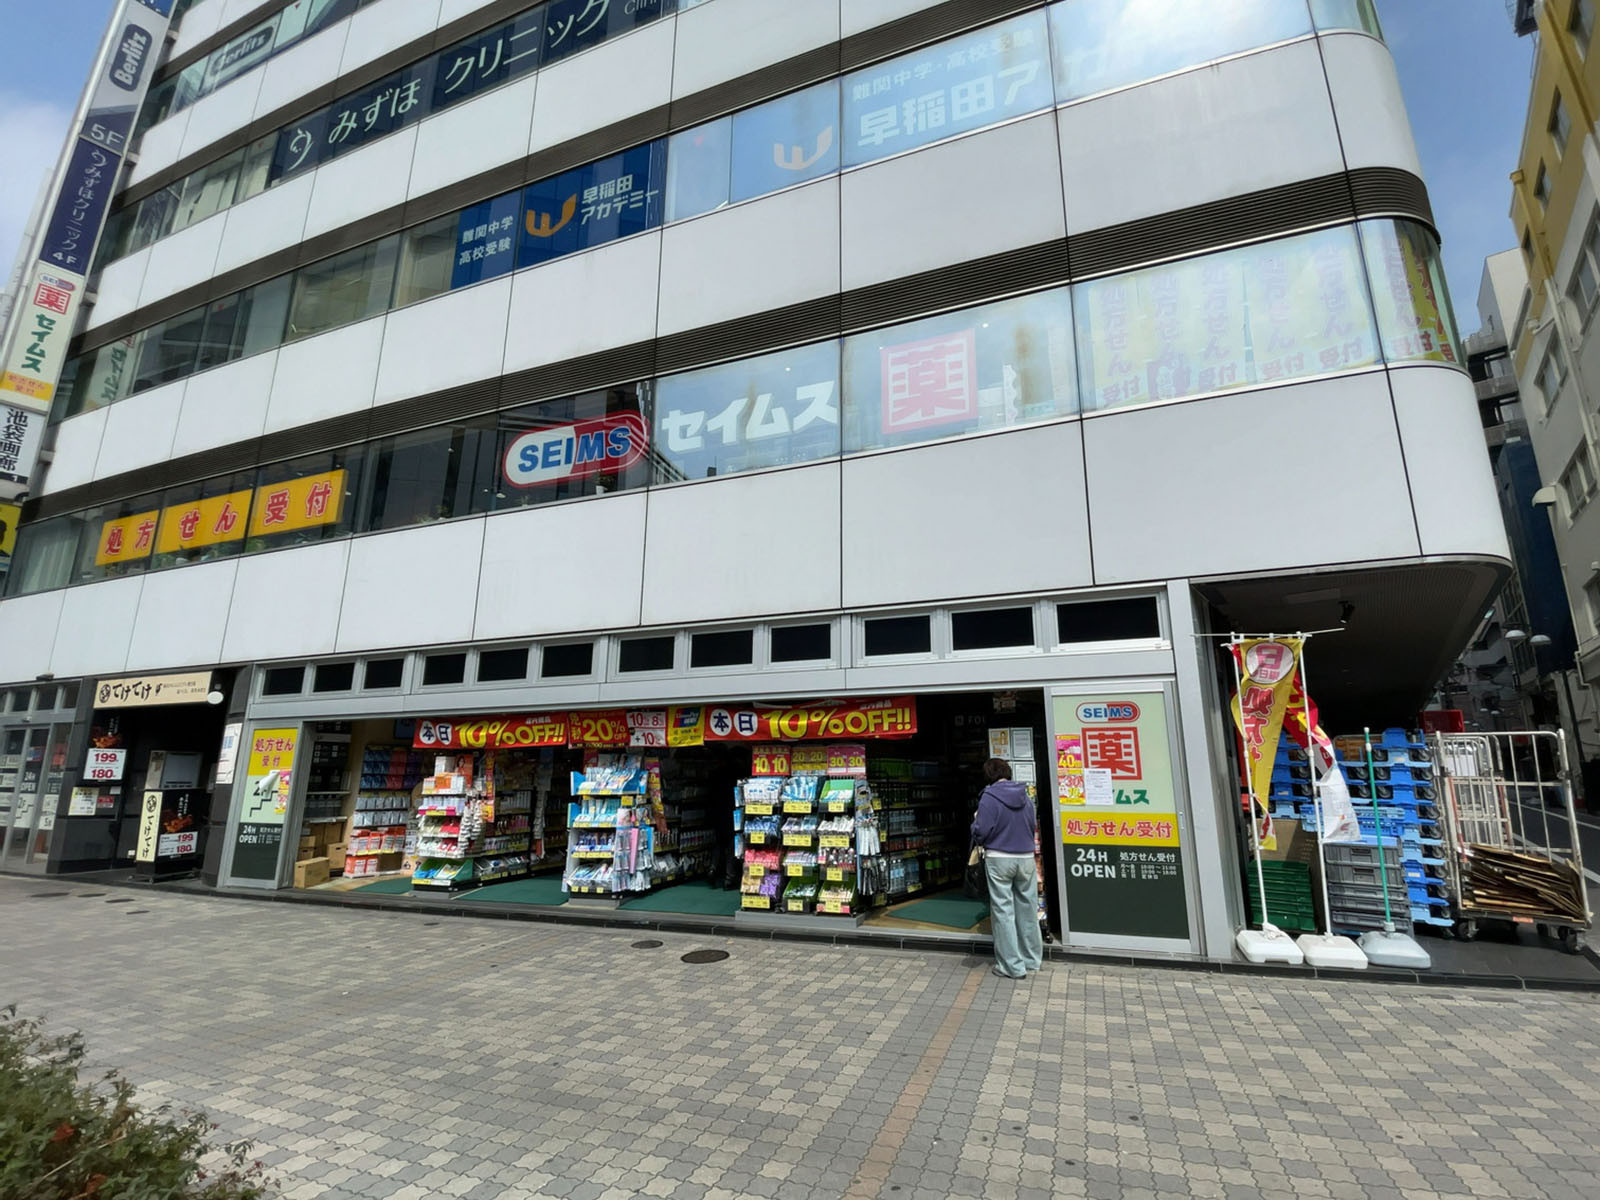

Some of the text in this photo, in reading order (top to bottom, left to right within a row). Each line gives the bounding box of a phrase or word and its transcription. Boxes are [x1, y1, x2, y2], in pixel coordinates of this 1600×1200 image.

[114, 31, 147, 86] Berlitz
[90, 123, 125, 146] 5F
[581, 174, 633, 204] 早稲田
[580, 189, 659, 225] アカデミー
[462, 215, 514, 245] 難関中学
[53, 252, 77, 264] 4F
[459, 237, 512, 265] 高校受験
[21, 313, 56, 373] セイムス
[661, 380, 838, 453] セイムス
[518, 426, 631, 473] SEIMS
[713, 712, 755, 732] 本日
[762, 708, 911, 739] 10%OFF!!
[1083, 707, 1133, 719] SEIMS
[422, 719, 565, 748] 本日 10%OFF!!
[1085, 731, 1138, 776] 薬
[1112, 789, 1149, 804] ムス
[239, 834, 258, 844] OPEN
[243, 825, 256, 834] 24H
[1066, 820, 1172, 838] 処方せん受付
[1076, 848, 1108, 862] 24H
[1120, 851, 1176, 863] 処方せん受付
[1071, 863, 1116, 879] OPEN
